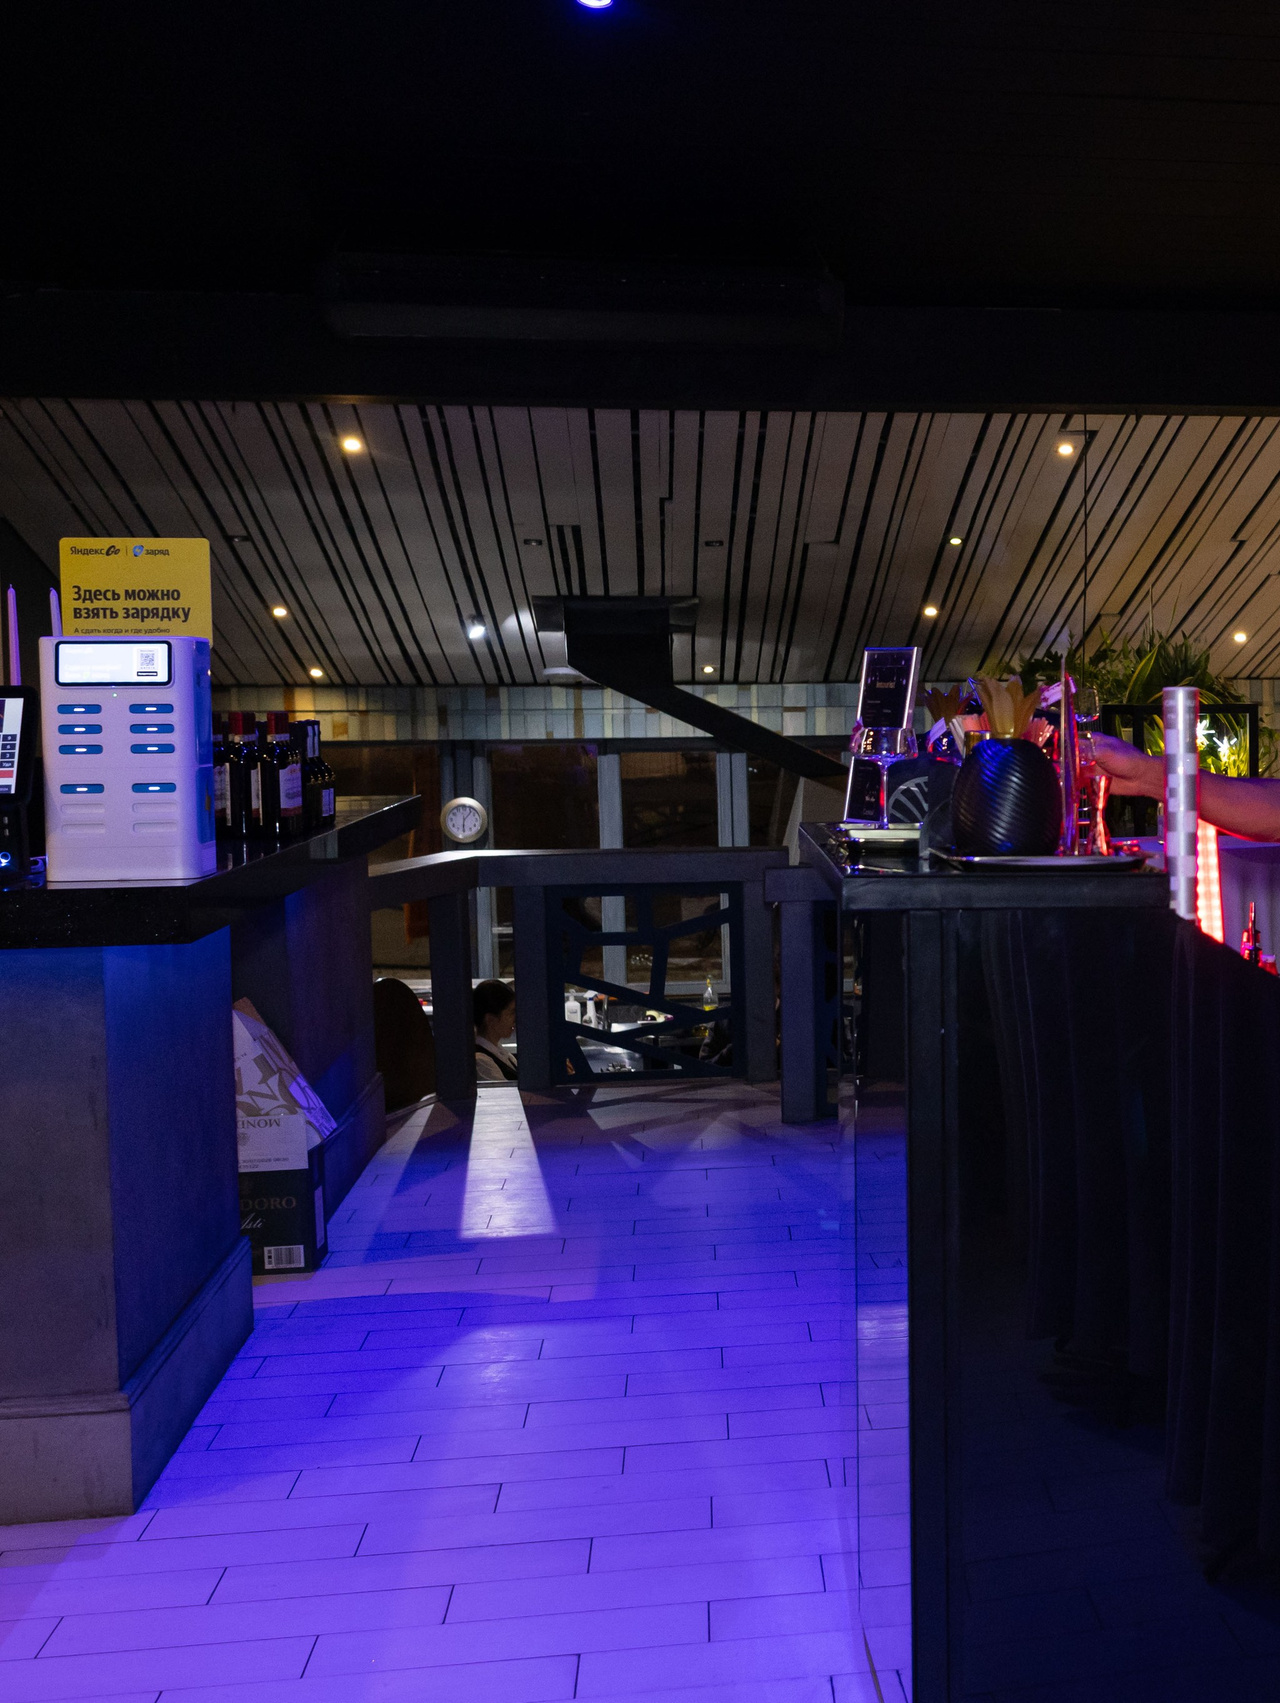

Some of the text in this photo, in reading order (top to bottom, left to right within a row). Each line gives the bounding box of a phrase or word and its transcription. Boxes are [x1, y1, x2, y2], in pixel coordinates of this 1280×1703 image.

[70, 545, 121, 557] Яндекс Go
[144, 547, 170, 557] заряд
[72, 585, 181, 604] Здесь можно
[73, 606, 191, 623] взять зарядку
